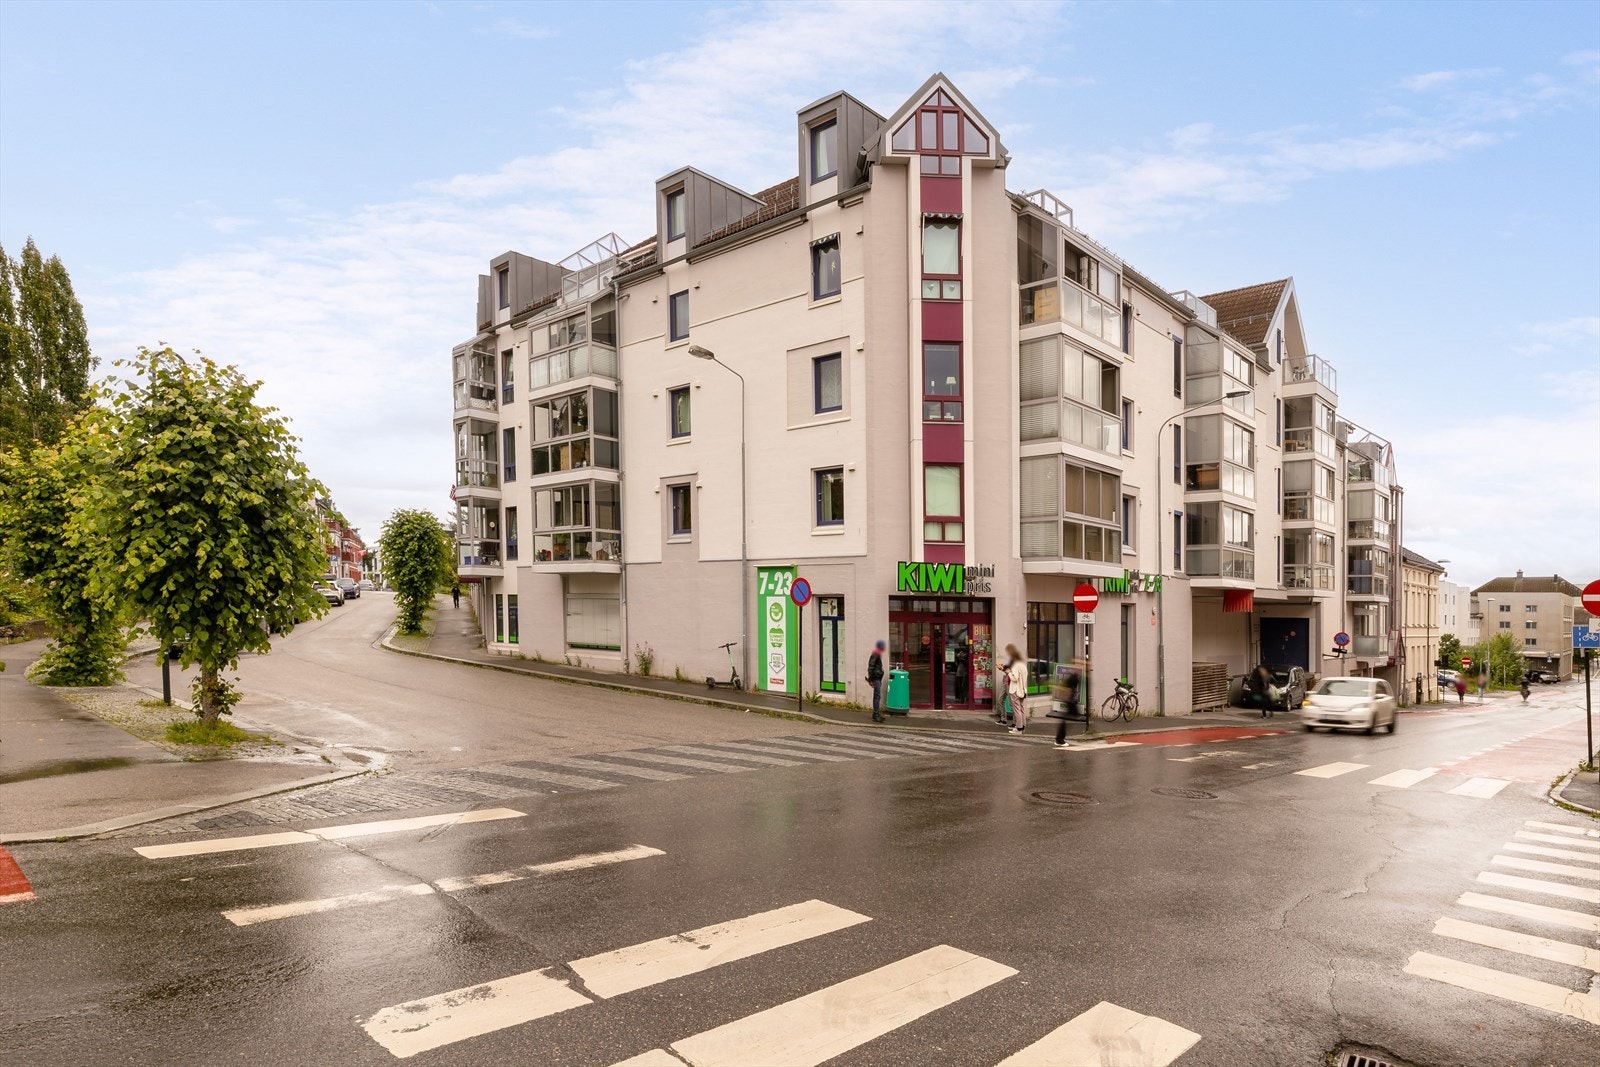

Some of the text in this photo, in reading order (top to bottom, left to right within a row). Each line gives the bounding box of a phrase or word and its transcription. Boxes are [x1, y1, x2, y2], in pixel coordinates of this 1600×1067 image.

[898, 561, 964, 593] KIWI
[967, 563, 995, 578] mini
[759, 571, 793, 595] 7-23
[967, 577, 992, 595] pris
